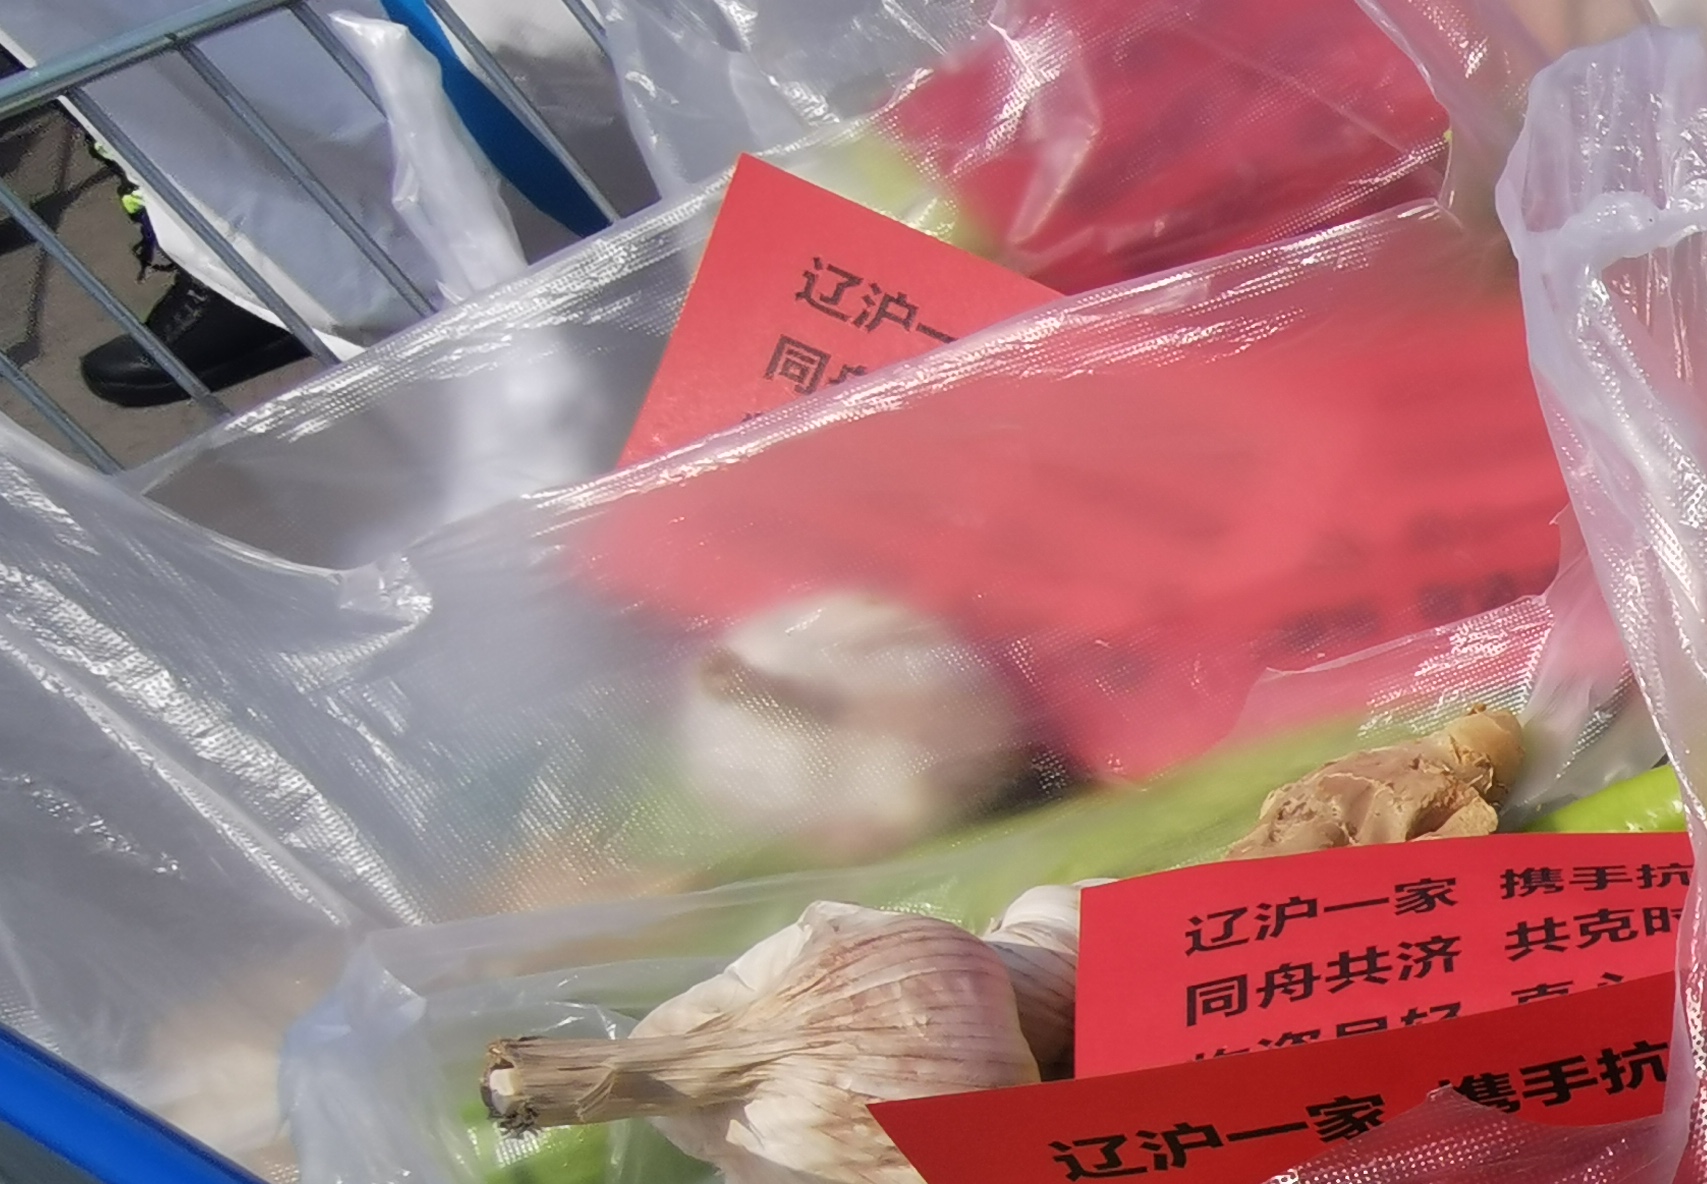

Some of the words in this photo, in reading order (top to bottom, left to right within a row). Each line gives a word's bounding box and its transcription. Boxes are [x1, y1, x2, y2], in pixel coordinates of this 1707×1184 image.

[1186, 878, 1456, 956] 辽沪一家
[1187, 936, 1460, 1027] 同舟共济
[1049, 1092, 1386, 1182] 辽沪一家
